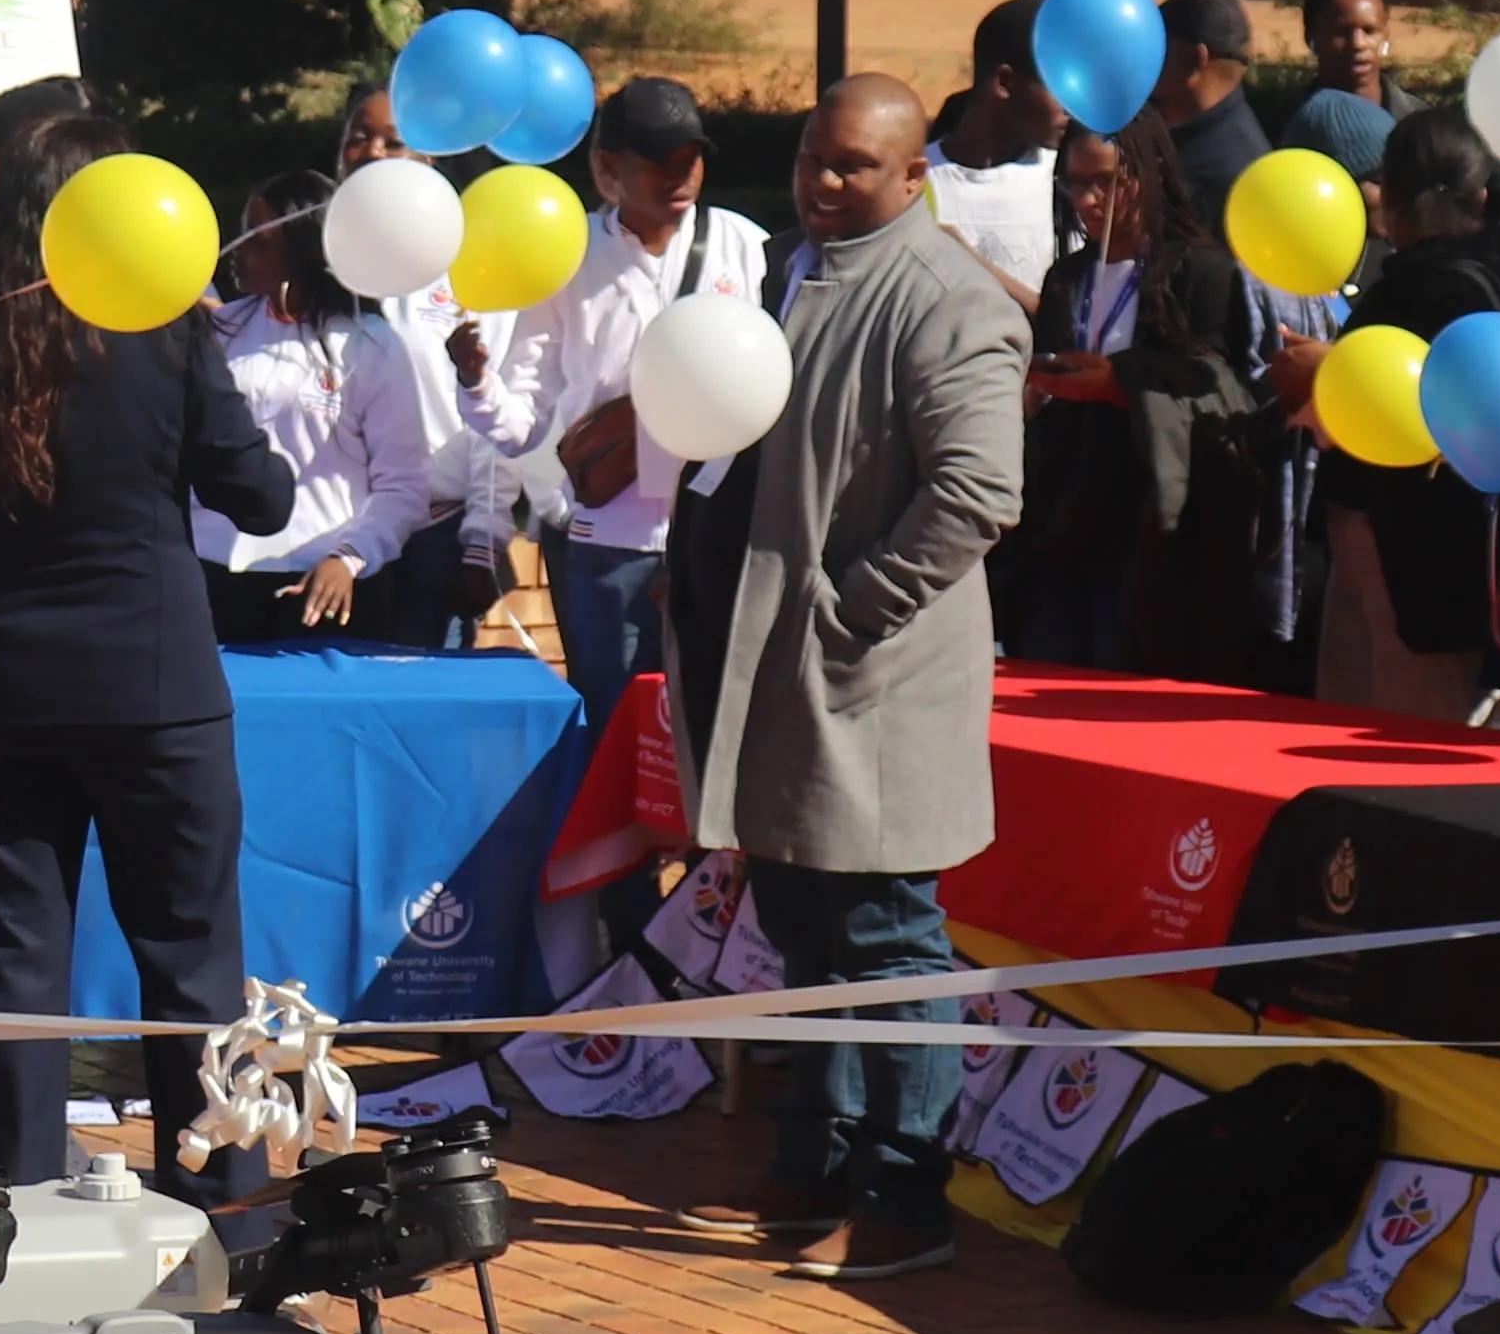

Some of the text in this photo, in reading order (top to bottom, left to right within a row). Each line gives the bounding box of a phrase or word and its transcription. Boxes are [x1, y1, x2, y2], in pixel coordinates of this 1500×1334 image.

[376, 955, 495, 969] Tshwane University
[392, 971, 478, 984] of Technology
